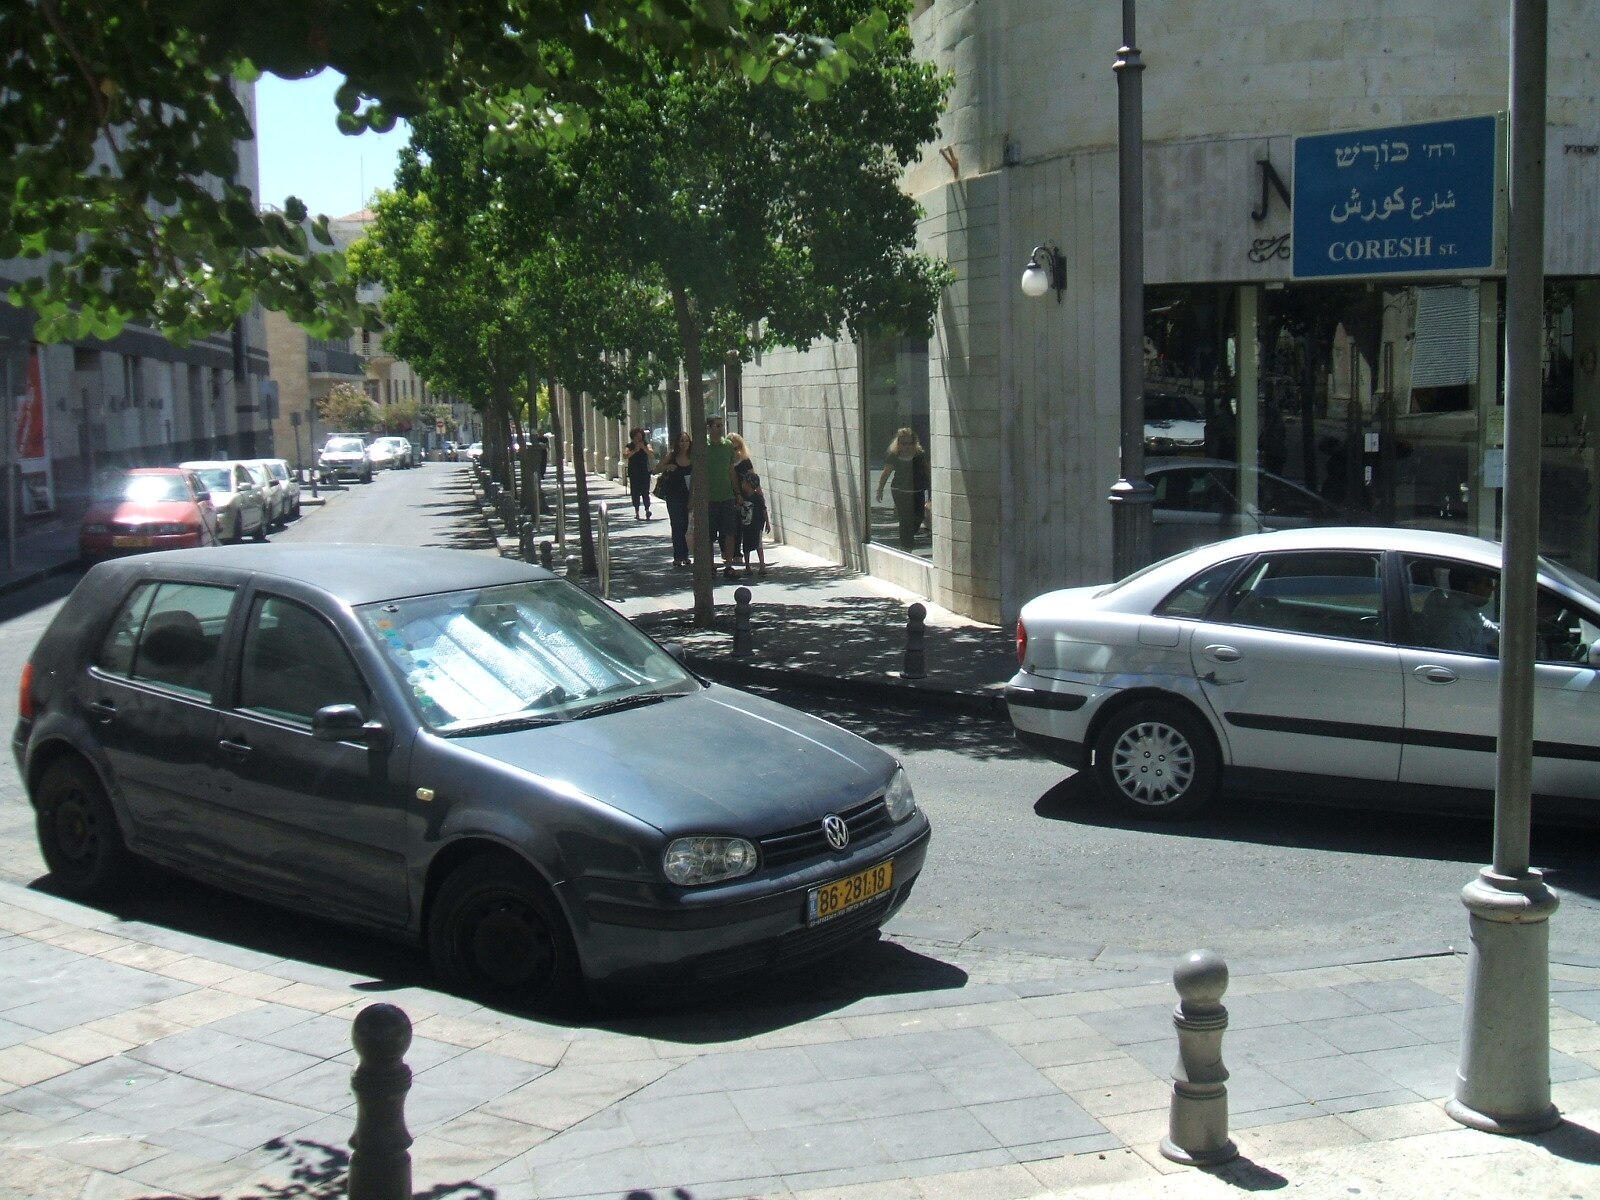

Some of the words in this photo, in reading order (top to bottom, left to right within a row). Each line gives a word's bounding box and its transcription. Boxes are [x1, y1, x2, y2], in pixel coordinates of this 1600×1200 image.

[1330, 186, 1405, 223] كورش
[1411, 190, 1456, 220] شارع
[1328, 236, 1432, 262] CORESH
[1439, 243, 1458, 255] ST.
